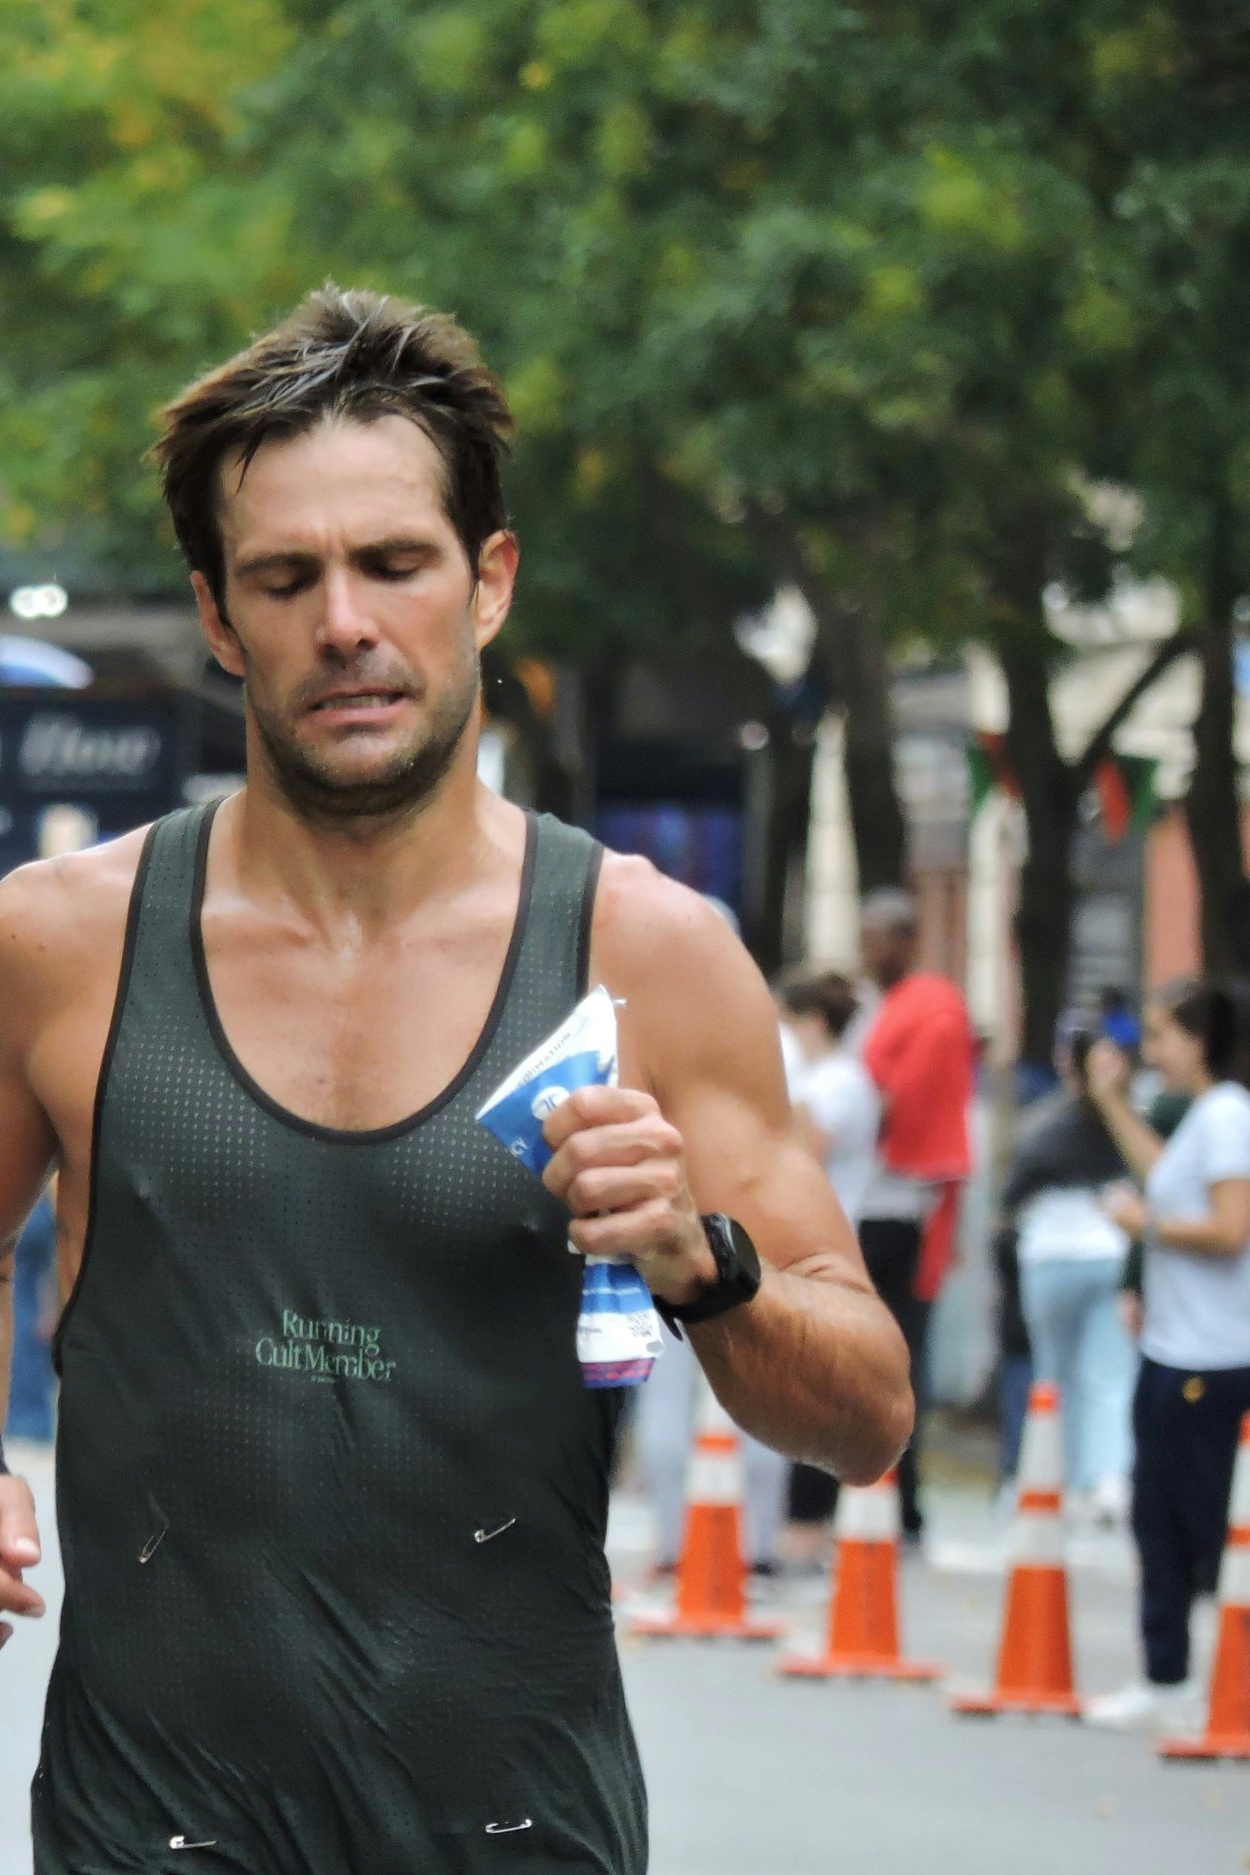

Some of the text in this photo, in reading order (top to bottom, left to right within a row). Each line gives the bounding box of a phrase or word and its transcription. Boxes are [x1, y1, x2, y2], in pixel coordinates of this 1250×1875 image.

[282, 1308, 382, 1356] Running
[255, 1337, 397, 1381] Cult Member
